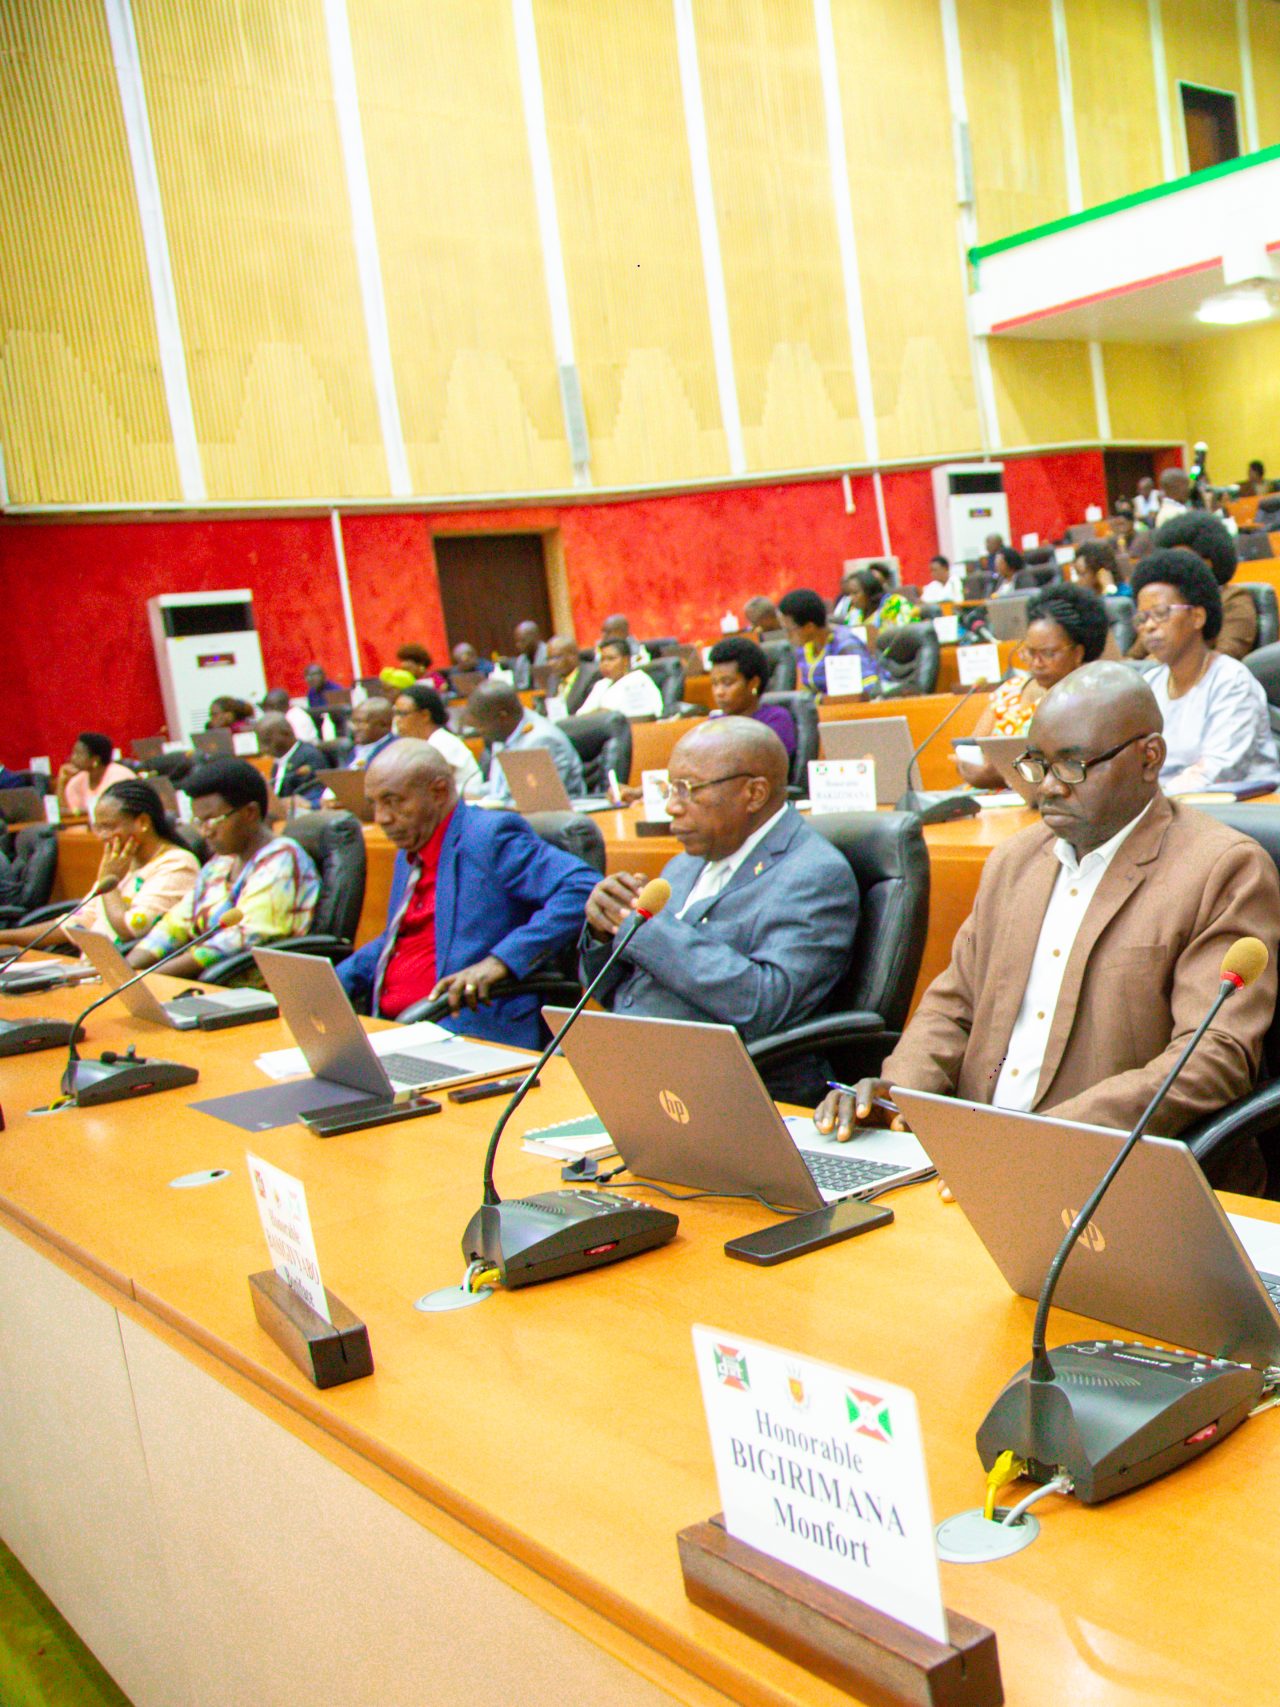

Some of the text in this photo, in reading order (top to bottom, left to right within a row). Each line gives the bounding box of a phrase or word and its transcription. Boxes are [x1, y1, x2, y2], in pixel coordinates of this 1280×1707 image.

[755, 1408, 863, 1474] Honorable
[730, 1437, 907, 1538] BIGIRIMANA
[773, 1497, 871, 1569] Monfort
